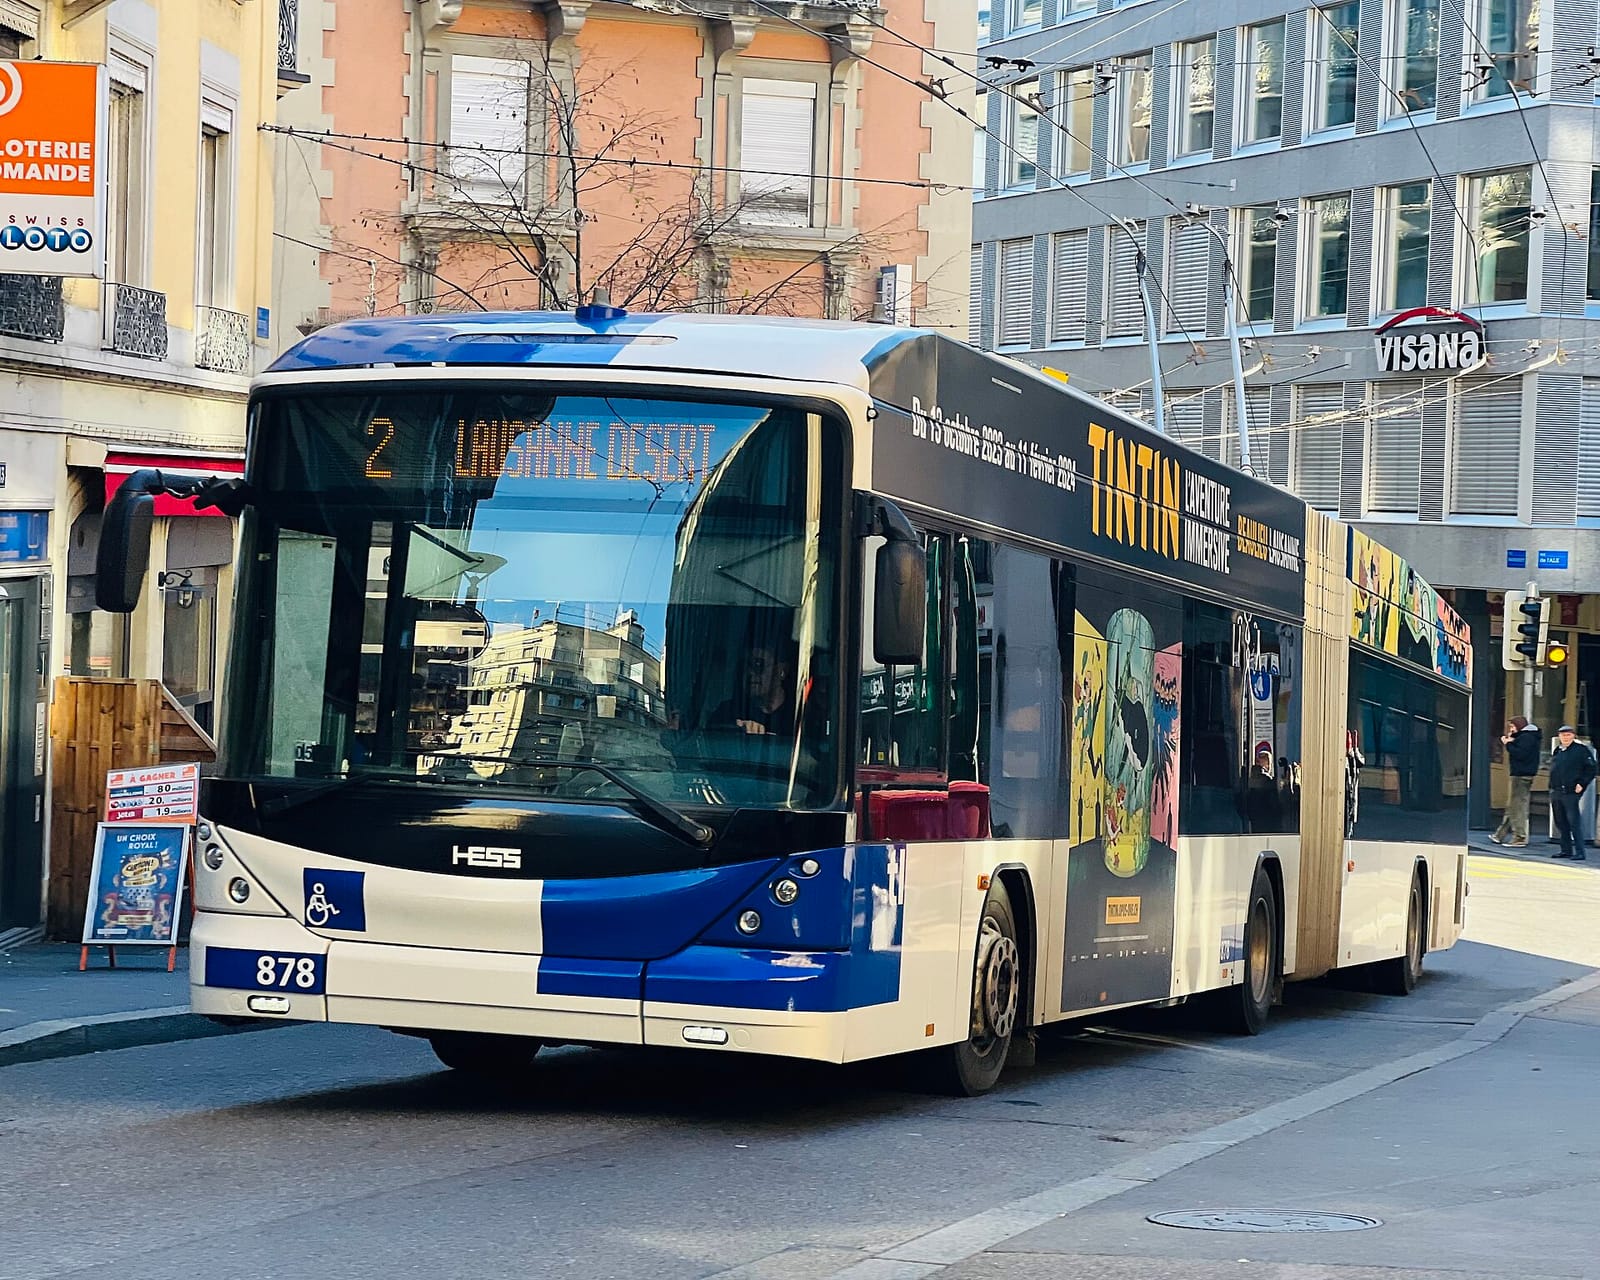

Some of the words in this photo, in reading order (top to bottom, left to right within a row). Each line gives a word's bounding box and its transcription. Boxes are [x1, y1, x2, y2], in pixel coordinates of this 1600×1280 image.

[0, 139, 91, 160] OTERIE
[8, 214, 84, 227] SWISS
[4, 228, 89, 251] LOTO
[365, 417, 394, 478] 2
[456, 420, 599, 479] LAUSANNE
[607, 423, 715, 482] DESERT
[911, 395, 928, 440] Du
[929, 405, 943, 445] 13
[943, 412, 980, 458] octobre
[981, 424, 1004, 467] 2023
[1004, 440, 1016, 471] au
[1017, 439, 1028, 475] 11
[1028, 442, 1055, 486] février
[1088, 422, 1180, 561] TINTIN
[1184, 468, 1231, 528] L'AVENTURE
[1184, 518, 1231, 575] IMMERSIVE
[139, 771, 176, 782] GAGNER
[157, 784, 171, 793] 80
[129, 833, 157, 842] CHOIX
[452, 845, 522, 869] HESS
[256, 955, 315, 988] 878
